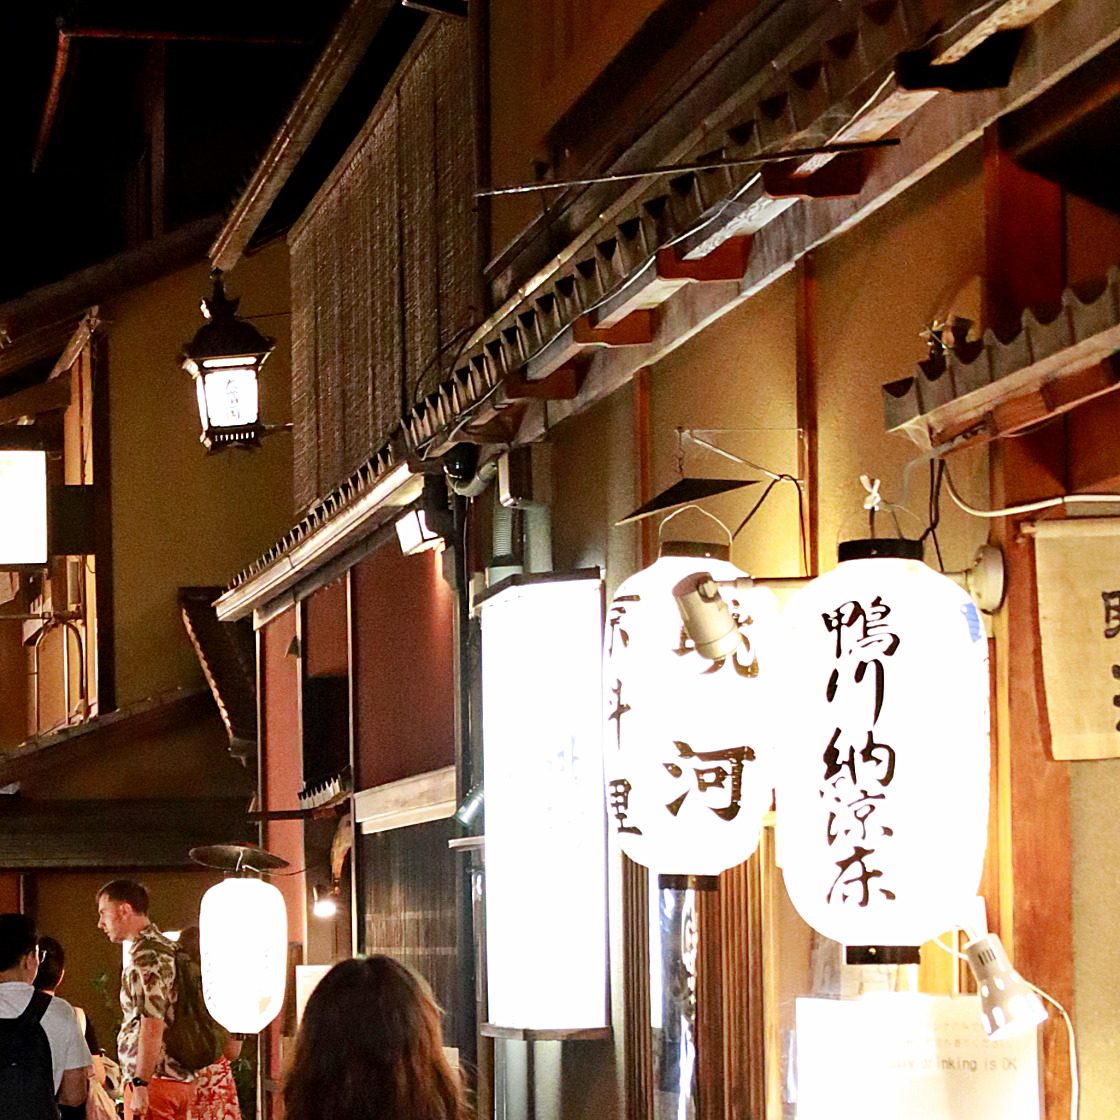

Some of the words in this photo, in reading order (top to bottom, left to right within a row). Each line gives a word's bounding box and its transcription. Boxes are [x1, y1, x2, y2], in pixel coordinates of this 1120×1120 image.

[820, 594, 901, 908] 鴨川納涼床
[984, 1057, 997, 1070] is
[1002, 1057, 1018, 1070] OK
